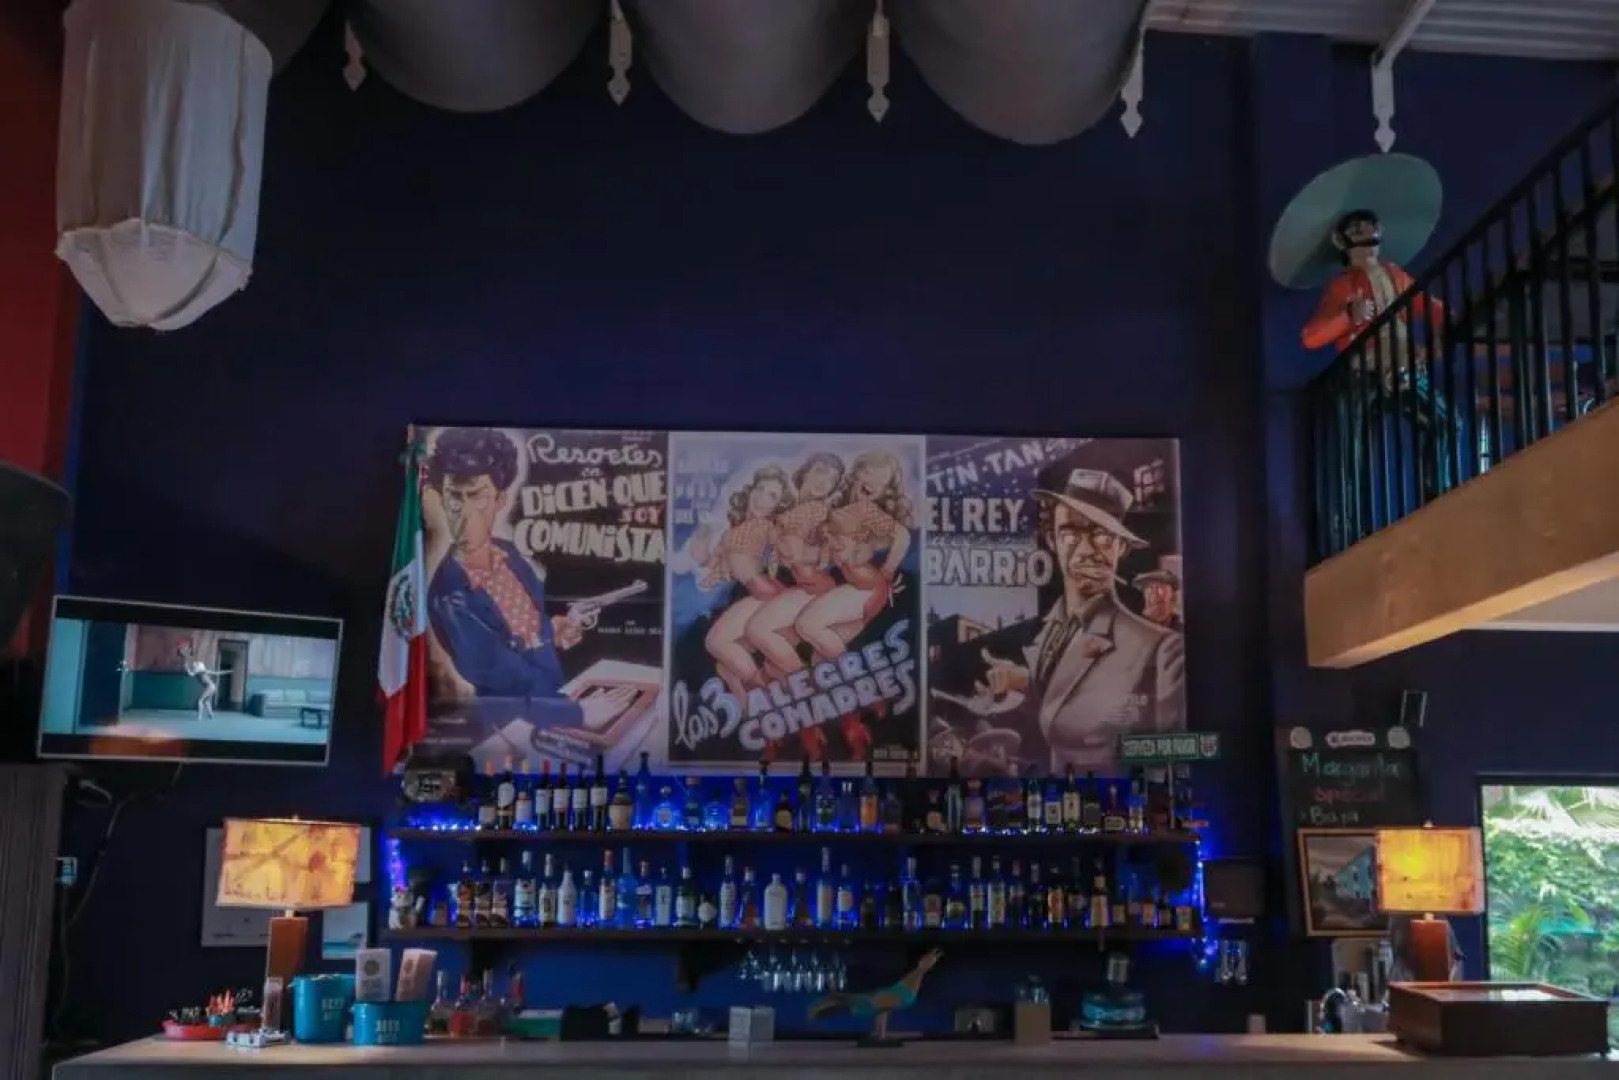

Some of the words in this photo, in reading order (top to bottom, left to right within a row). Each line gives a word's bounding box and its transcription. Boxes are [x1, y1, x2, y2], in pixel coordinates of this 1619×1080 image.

[526, 434, 662, 469] Resortes
[926, 497, 956, 533] EL
[962, 497, 1025, 533] REY
[701, 677, 741, 739] 3
[747, 619, 909, 718] ALEGRES
[738, 658, 916, 750] COMADRES
